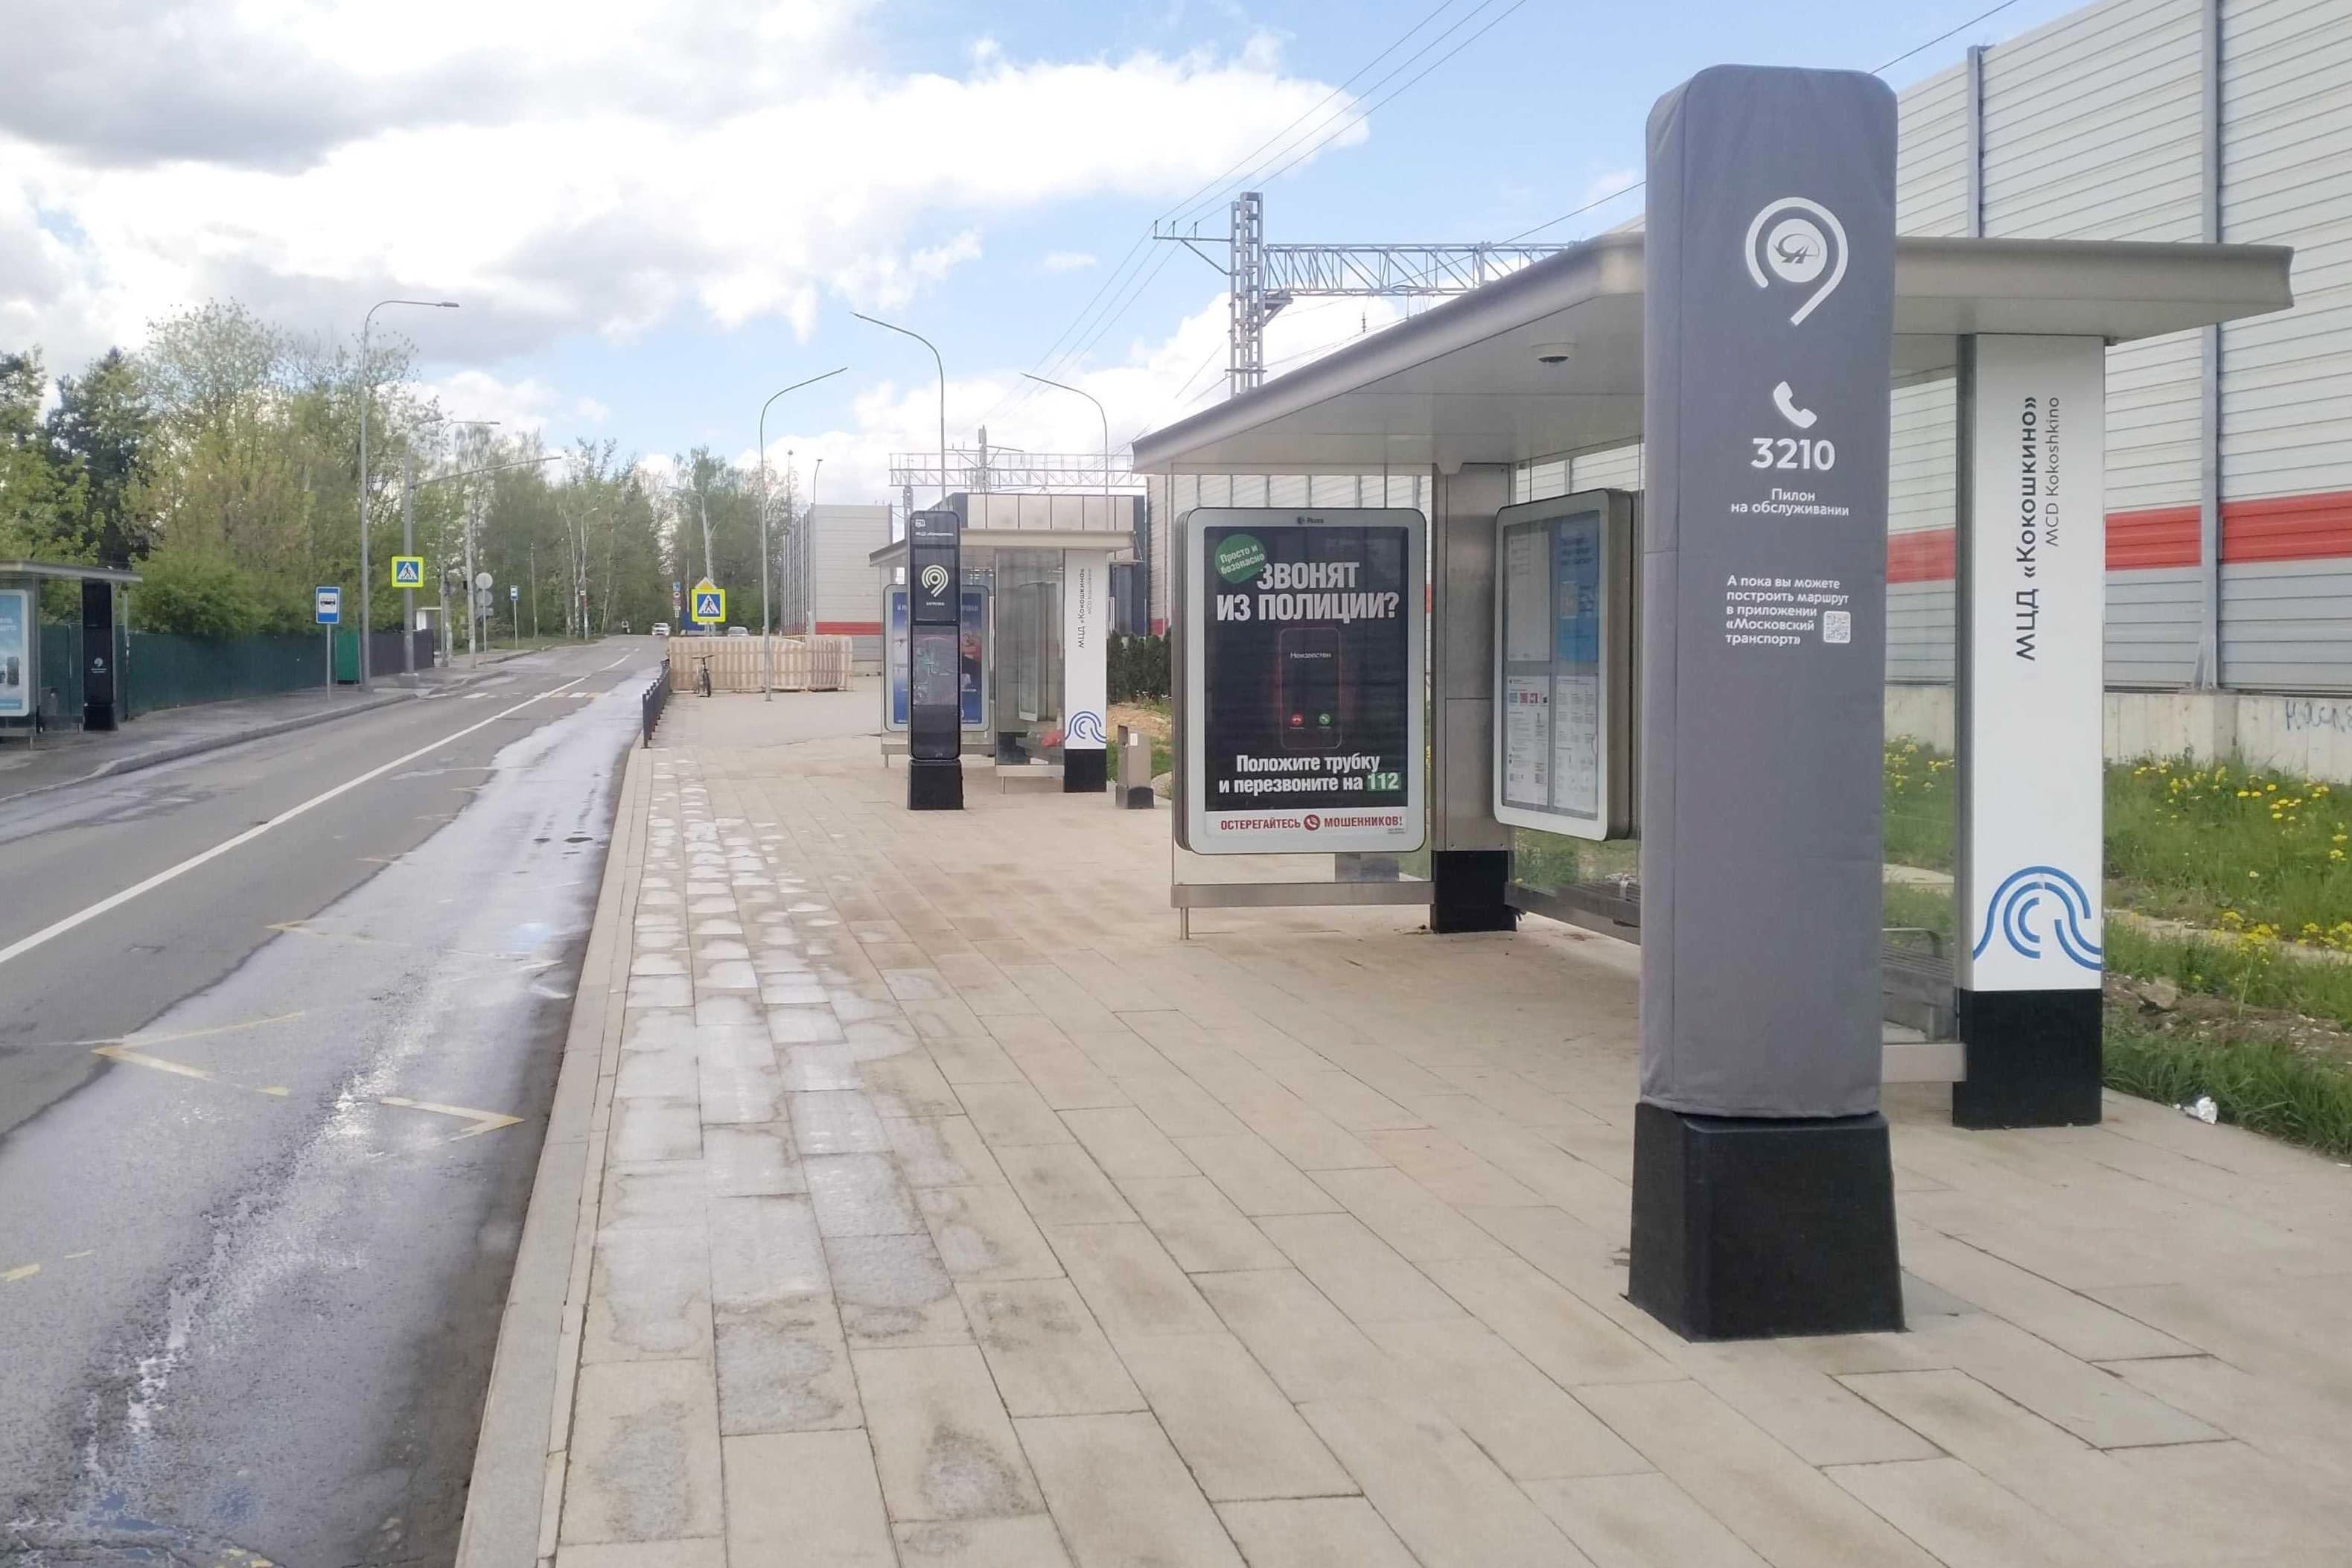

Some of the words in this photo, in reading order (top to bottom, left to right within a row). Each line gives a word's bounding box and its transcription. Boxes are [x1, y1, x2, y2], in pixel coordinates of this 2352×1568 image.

[1751, 438, 1835, 471] 3210
[2045, 396, 2059, 497] Kokoshkino
[1771, 488, 1815, 502] Пилон
[2015, 396, 2037, 579] «Кокошкино»
[1731, 503, 1748, 513] на
[1752, 500, 1849, 516] обслуживании
[2045, 503, 2059, 547] MCD
[1220, 547, 1250, 564] Просто
[1250, 544, 1258, 555] и
[1256, 561, 1360, 590] ЗВОНЯТ
[1727, 575, 1737, 587] А
[1741, 577, 1772, 587] пока
[1775, 578, 1791, 587] вы
[1794, 579, 1841, 589] можете
[1217, 594, 1252, 622] ИЗ
[1258, 592, 1400, 624] ПОЛИЦИИ?
[1727, 592, 1794, 603] построить
[1797, 593, 1849, 605] маршрут
[1726, 606, 1734, 615] в
[1737, 606, 1817, 617] приложении
[1726, 618, 1814, 631] «Московский
[2015, 588, 2039, 661] МЦД
[1725, 634, 1800, 647] транспорт»
[1236, 754, 1321, 772] Положите
[1324, 752, 1380, 774] трубку
[1219, 780, 1229, 794] и
[1234, 777, 1339, 796] перезвоните
[1342, 777, 1363, 791] на
[1367, 771, 1400, 791] 112
[1220, 816, 1301, 831] ОСТЕРЕГАЙТЕСЬ
[1324, 815, 1403, 828] МОШЕННИКОВ!
